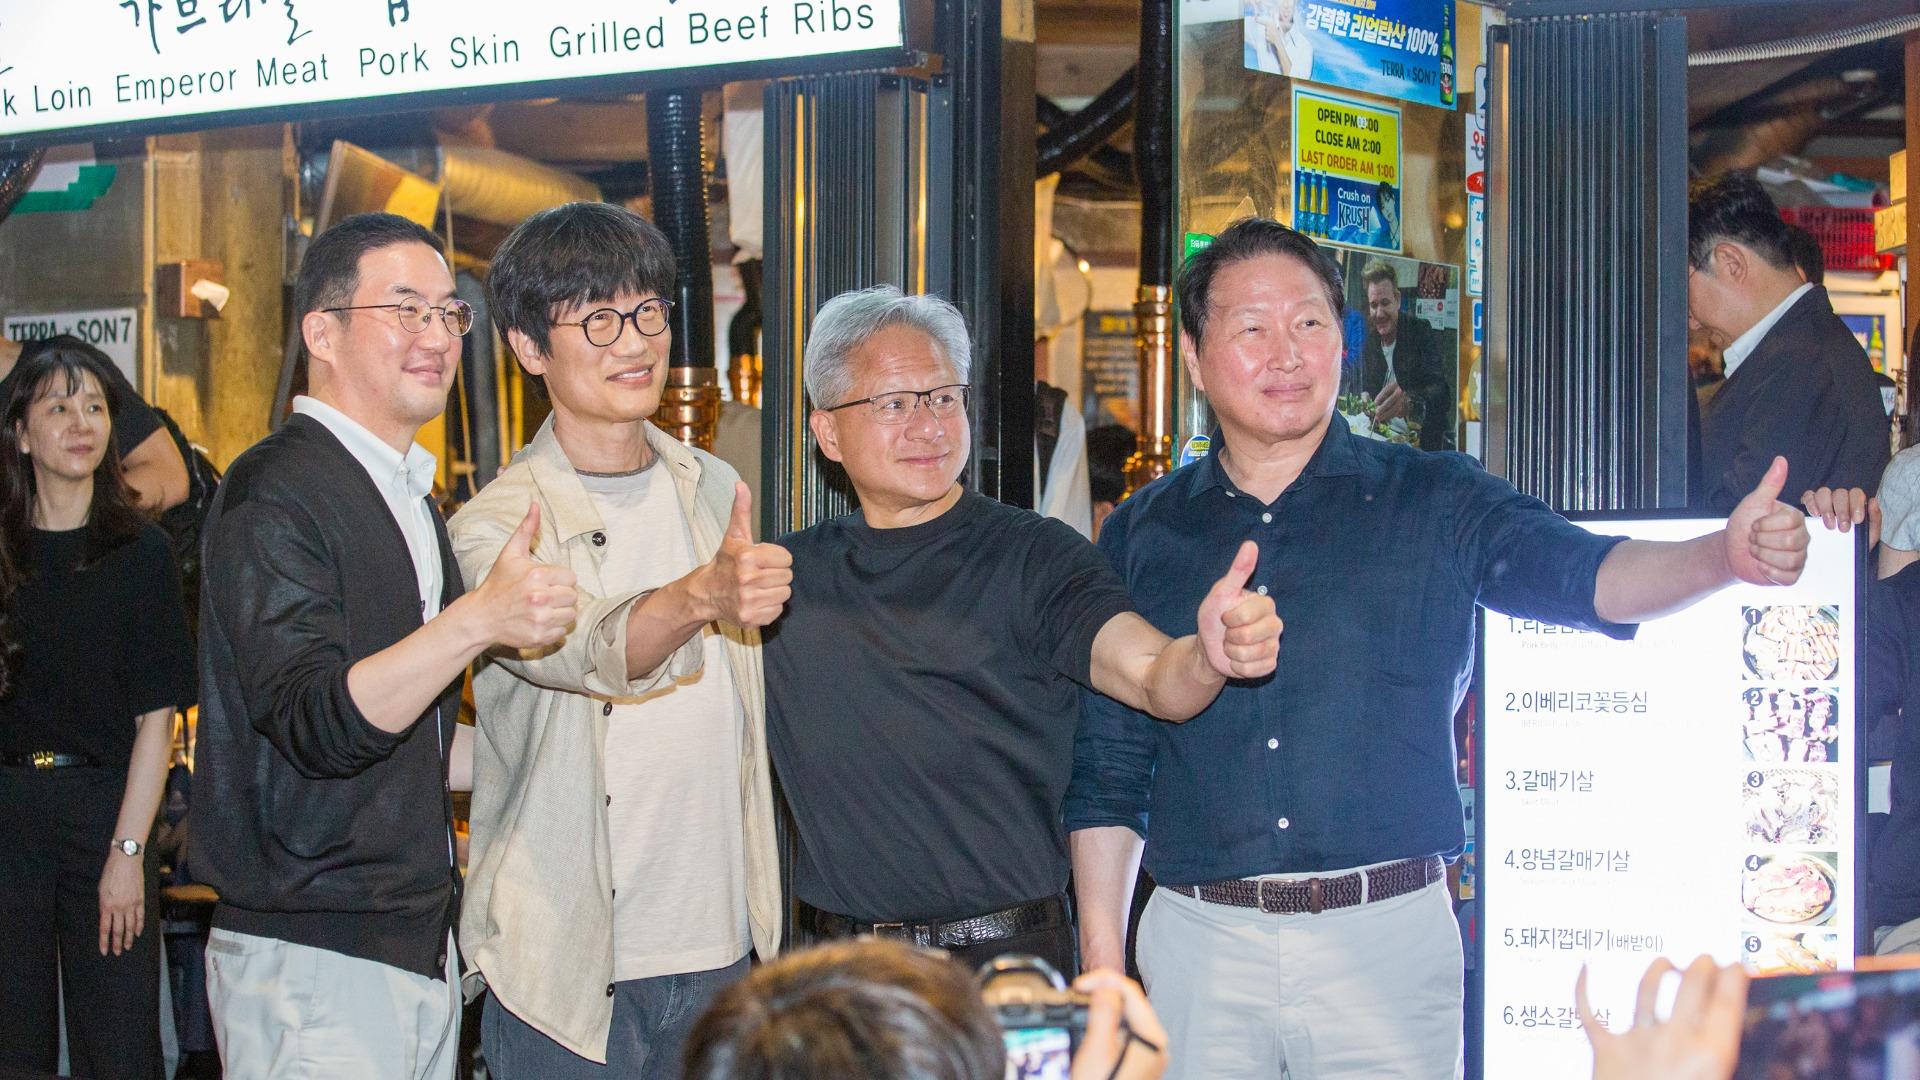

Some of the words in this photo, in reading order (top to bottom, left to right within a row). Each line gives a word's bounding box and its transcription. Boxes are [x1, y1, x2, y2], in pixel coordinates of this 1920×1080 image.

[1305, 3, 1351, 37] 강력한
[1349, 11, 1407, 49] 리얼탄산
[1406, 26, 1438, 57] 100%
[34, 81, 91, 112] Loin
[116, 69, 237, 105] Emperor
[257, 54, 329, 87] Meat
[360, 43, 429, 77] Pork
[450, 34, 519, 69] Skin
[550, 17, 664, 58] Grilled
[689, 6, 768, 44] Beef
[794, 1, 874, 35] Ribs
[1380, 59, 1405, 80] TERRA
[1317, 107, 1342, 125] OPEN
[1344, 113, 1358, 128] PM
[1315, 129, 1343, 148] CLOSE
[1346, 136, 1360, 151] AM
[1362, 139, 1381, 155] 2:00
[1301, 149, 1324, 166] LAST
[1327, 154, 1358, 172] ORDER
[1360, 160, 1374, 175] AM
[1376, 163, 1395, 179] 1:00
[1337, 187, 1360, 202] Crush
[1361, 194, 1371, 204] on
[1337, 201, 1371, 233] KRUSH
[1506, 691, 1646, 713] 2.이베리코꽃등심
[1506, 770, 1594, 792] 3.갈매기살
[1505, 849, 1630, 871] 4.양념갈매기살
